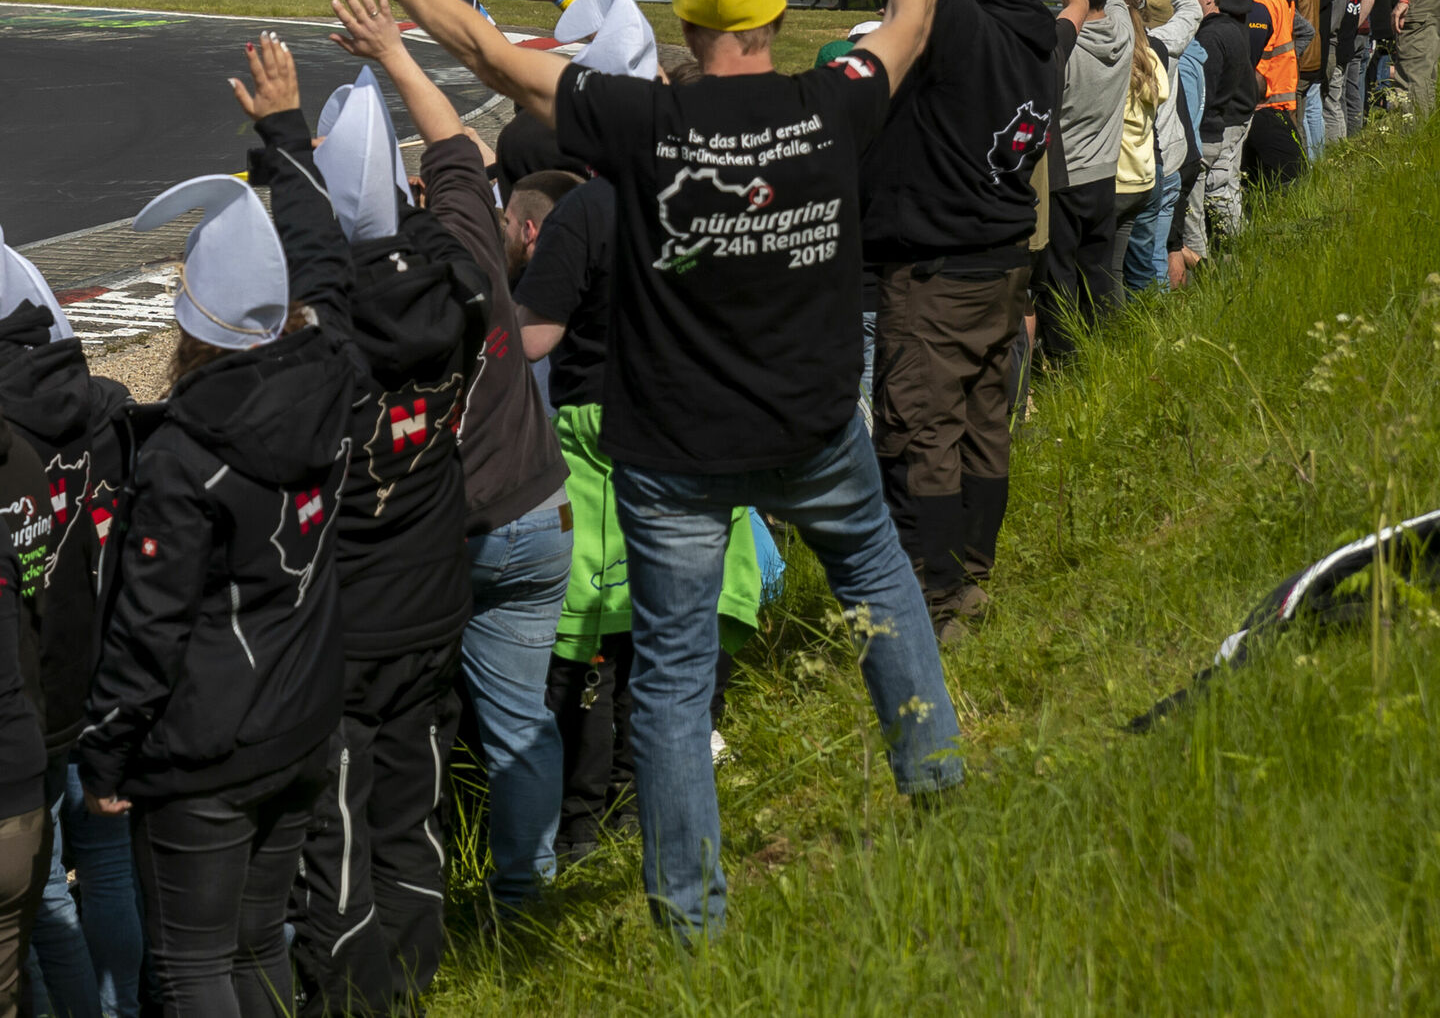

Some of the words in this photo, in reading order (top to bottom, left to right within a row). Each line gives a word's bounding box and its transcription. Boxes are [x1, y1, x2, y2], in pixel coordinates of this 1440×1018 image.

[656, 141, 678, 159] ins
[709, 132, 737, 149] das
[741, 127, 772, 149] Kind
[689, 197, 842, 234] nürburgring
[713, 234, 757, 256] 24h
[762, 222, 840, 253] Rennen
[788, 240, 837, 269] 2018
